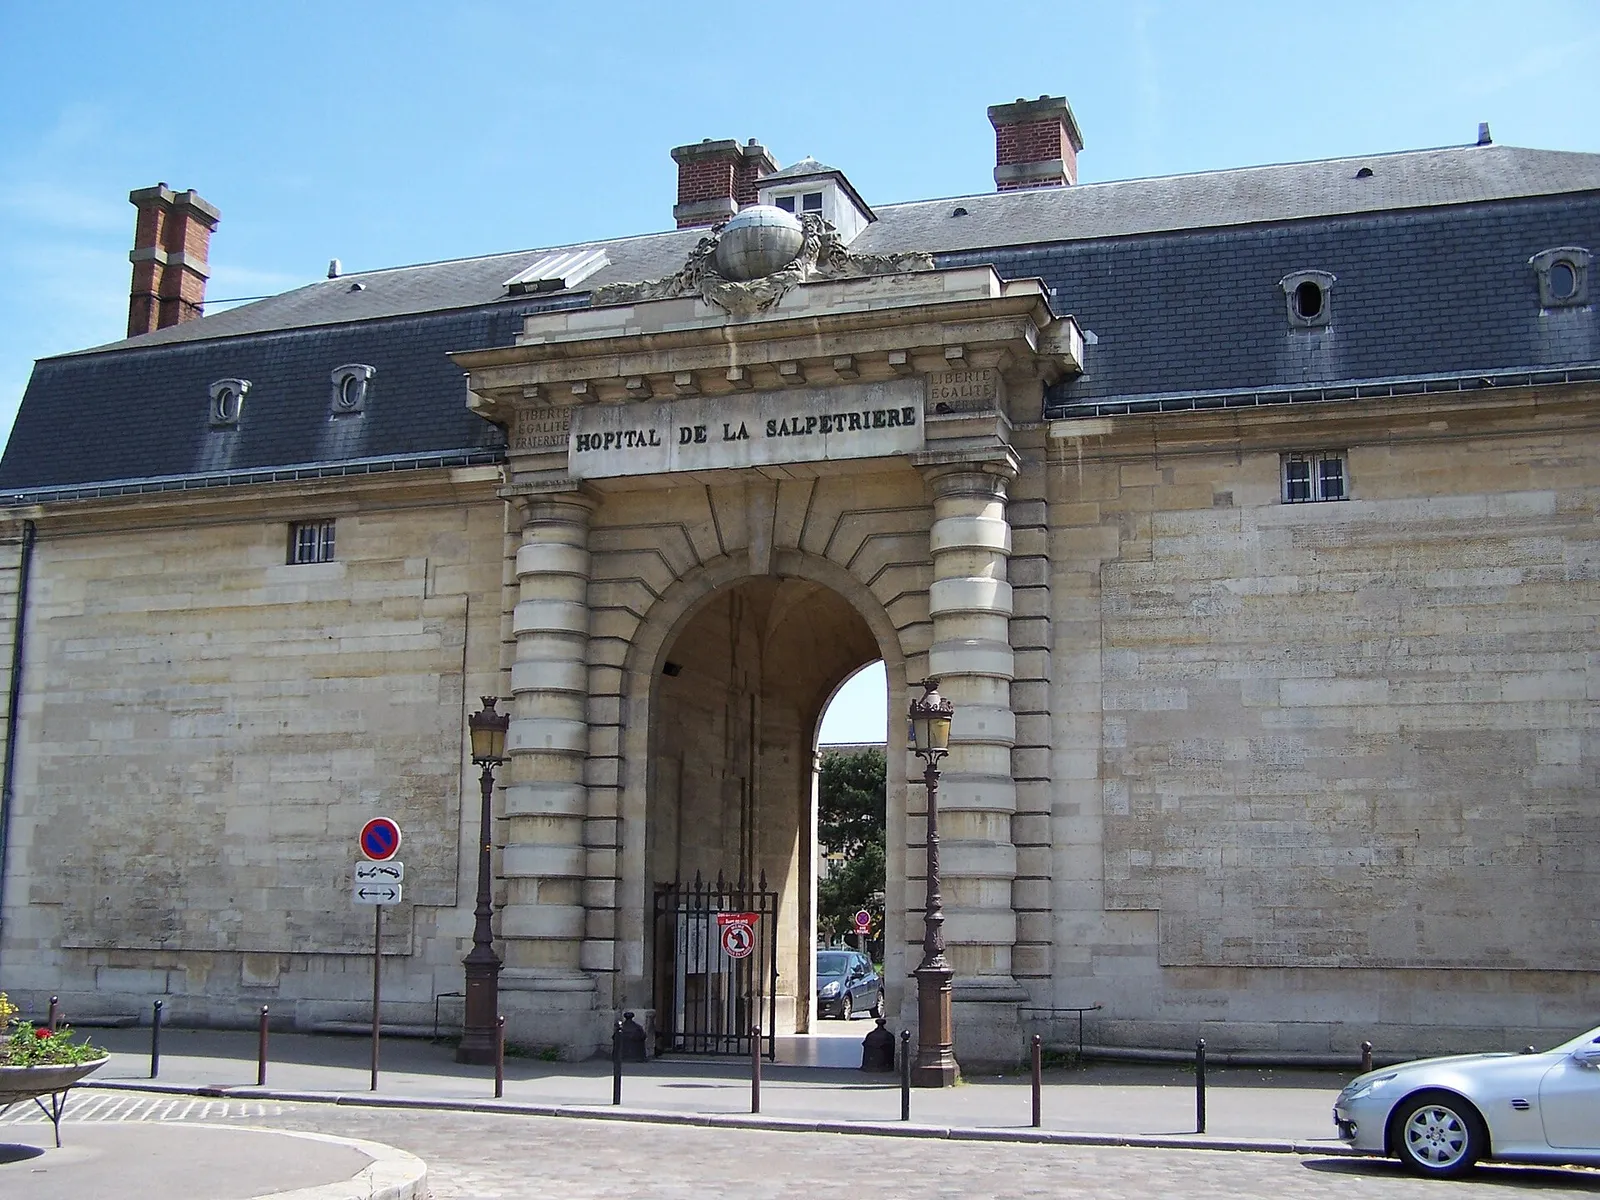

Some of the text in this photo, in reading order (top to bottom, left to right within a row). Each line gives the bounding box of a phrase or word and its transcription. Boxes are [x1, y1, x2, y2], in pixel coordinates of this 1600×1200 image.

[576, 407, 916, 452] HOPITAL DE LA SALPETRIERE
